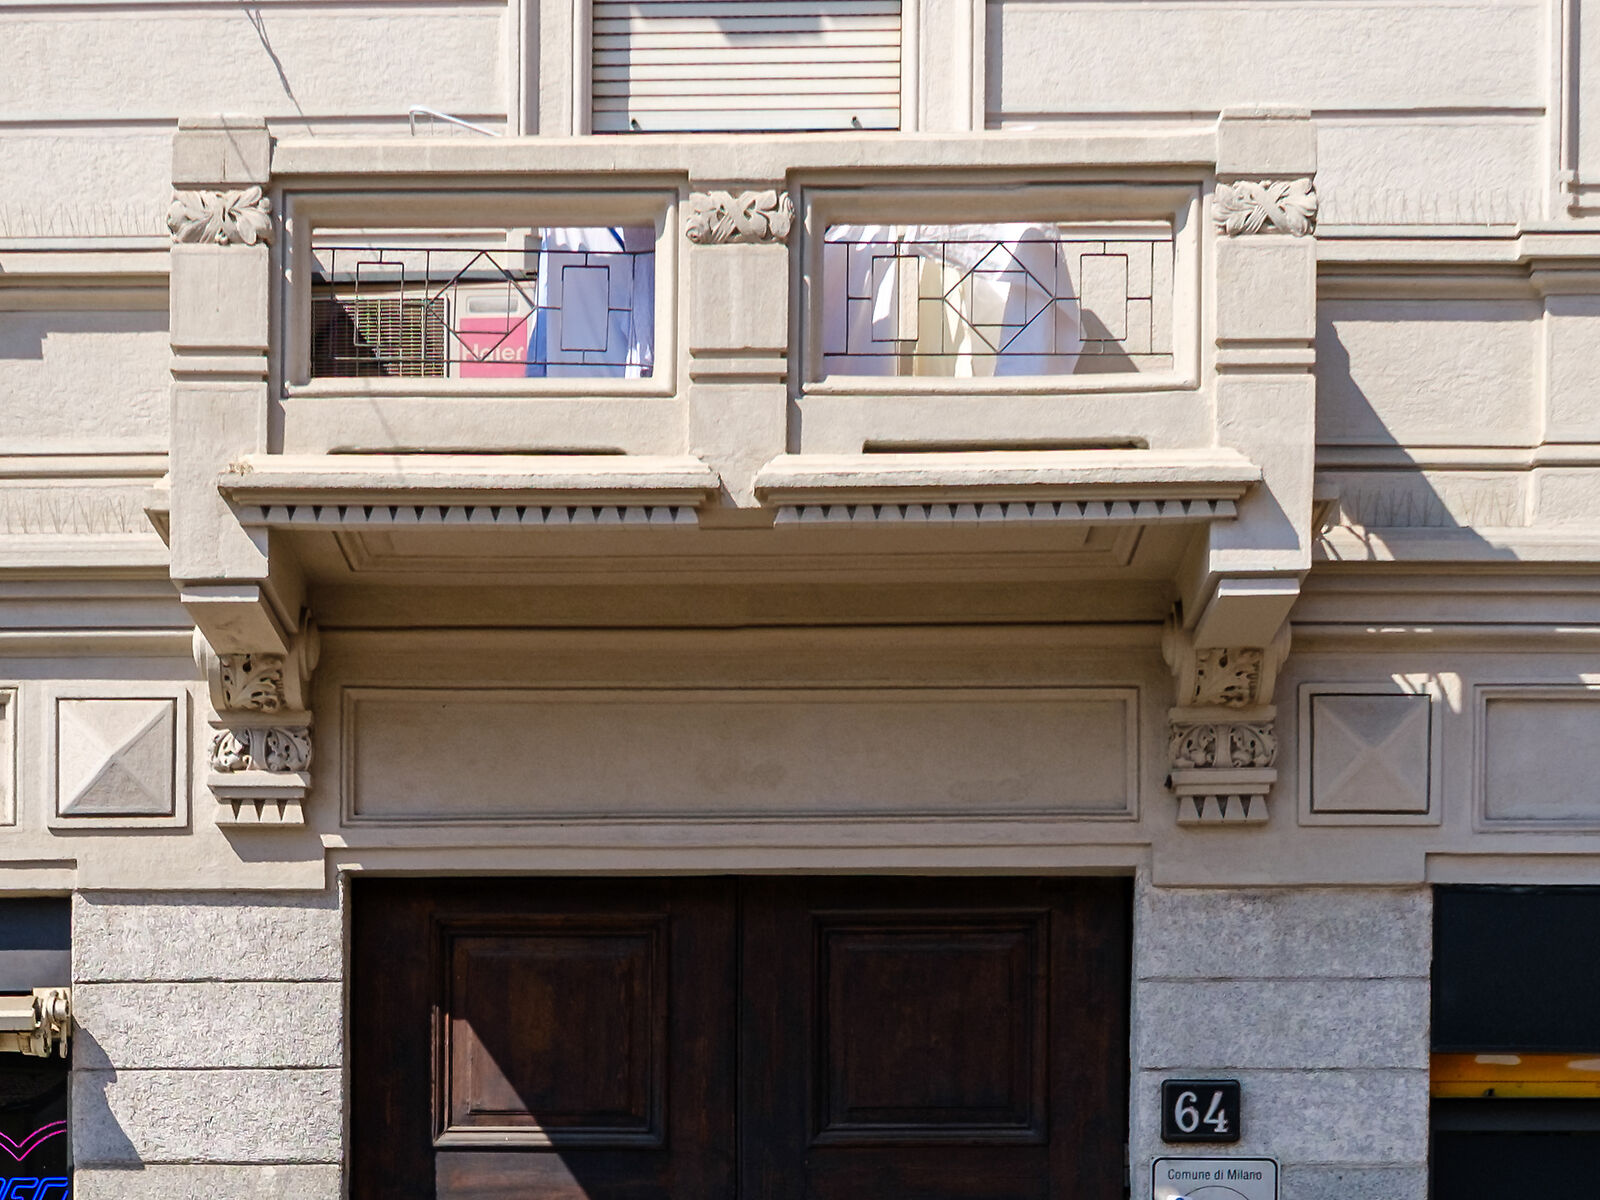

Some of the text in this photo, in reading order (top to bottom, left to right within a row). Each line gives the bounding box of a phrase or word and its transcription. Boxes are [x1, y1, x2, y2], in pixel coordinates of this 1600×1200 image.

[1174, 1091, 1229, 1133] 64
[1167, 1168, 1263, 1180] Comune di Milano
